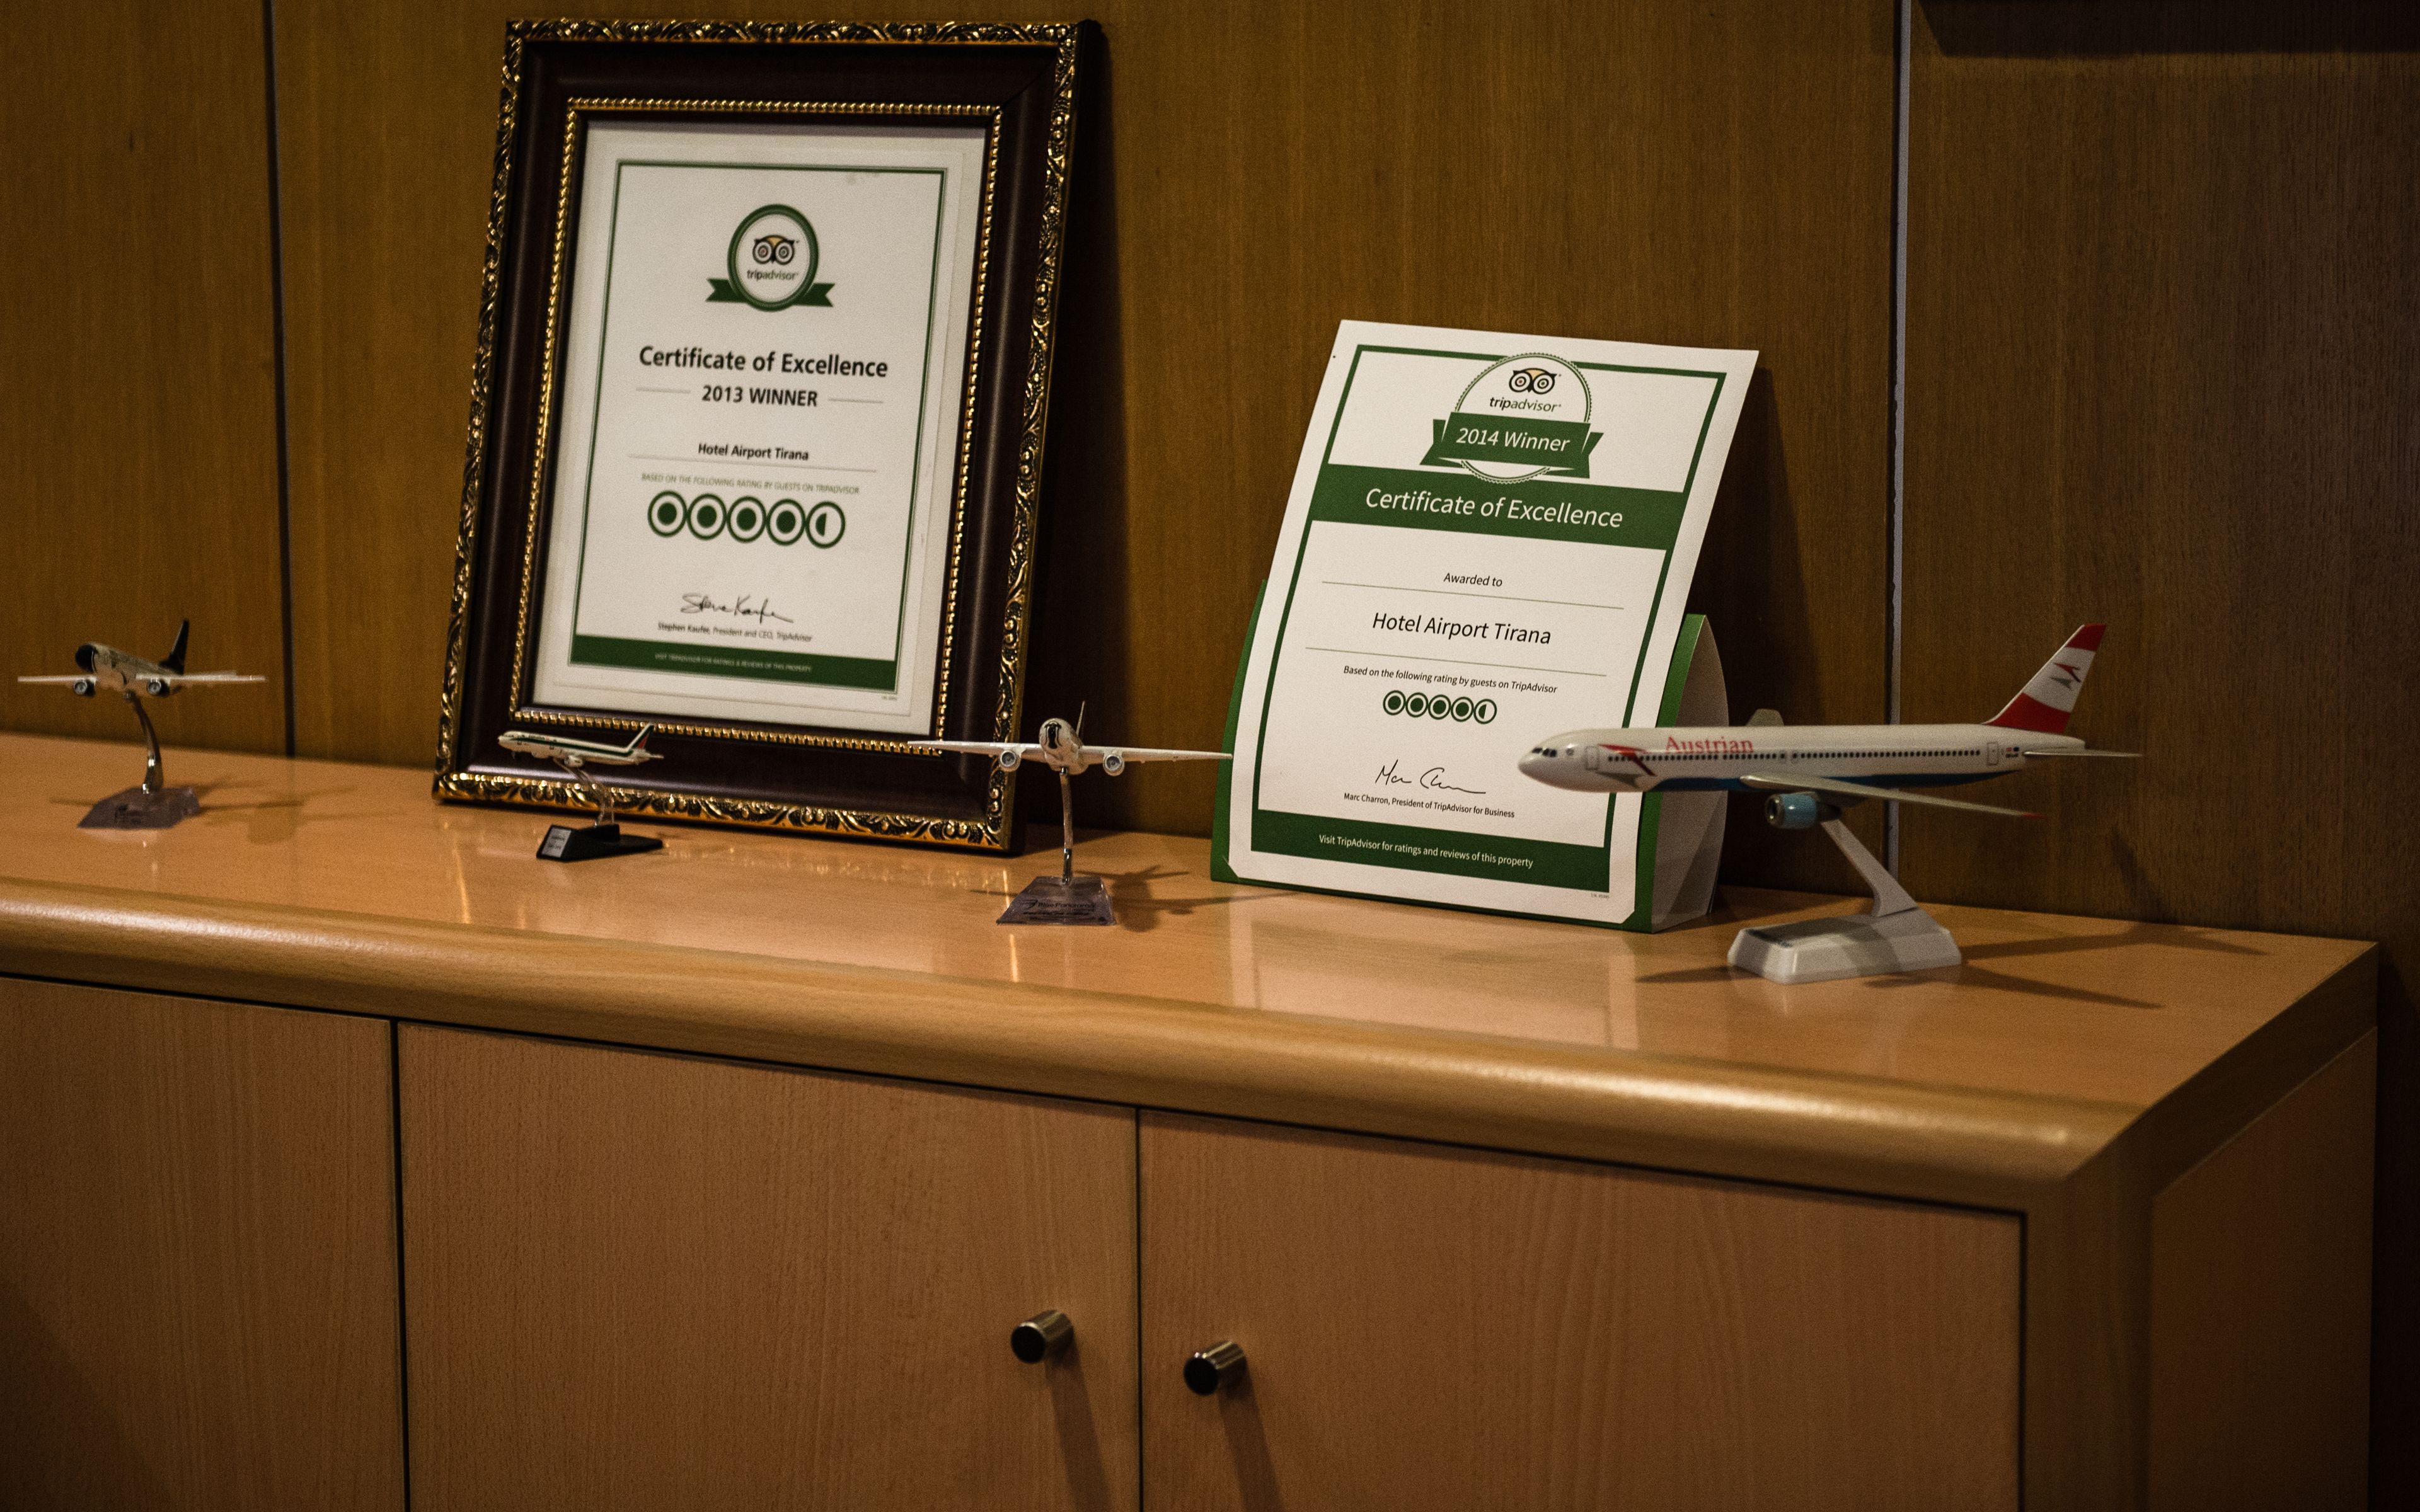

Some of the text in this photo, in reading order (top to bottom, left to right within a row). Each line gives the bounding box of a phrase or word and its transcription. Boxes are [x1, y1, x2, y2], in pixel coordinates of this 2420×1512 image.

[746, 269, 797, 281] tripadvisor
[638, 345, 888, 377] Certificate of Excellence
[701, 384, 818, 407] 2013 WINNER
[1489, 396, 1559, 412] tripadvisor
[1455, 427, 1570, 452] 2014 Winner
[698, 443, 809, 461] Hotel Airport Tirana
[641, 472, 664, 482] BASED
[679, 475, 691, 483] THE
[736, 479, 762, 488] RATING
[1365, 487, 1623, 528] Certificate of Excellence
[1443, 573, 1502, 587] Awarded to
[658, 622, 685, 631] Stephen
[713, 626, 742, 636] President
[776, 632, 812, 641] TripAdvisor
[1372, 612, 1551, 644] Hotel Airport Tirana
[1343, 665, 1368, 675] Based
[1381, 668, 1394, 678] the
[1395, 670, 1432, 683] following
[1433, 675, 1458, 685] rating
[1458, 675, 1469, 686] by
[1470, 679, 1496, 687] guests
[1511, 680, 1557, 692] TripAdvisor
[1665, 736, 1754, 755] Austrian
[1344, 793, 1359, 801] Marc
[1361, 794, 1390, 805] Charron,
[1392, 797, 1424, 808] President
[1434, 801, 1472, 813] TripAdvisor
[1473, 806, 1483, 814] for
[1484, 807, 1514, 818] Business
[1318, 834, 1533, 869] Visit TripAdvisor for ratings and reviews of this property
